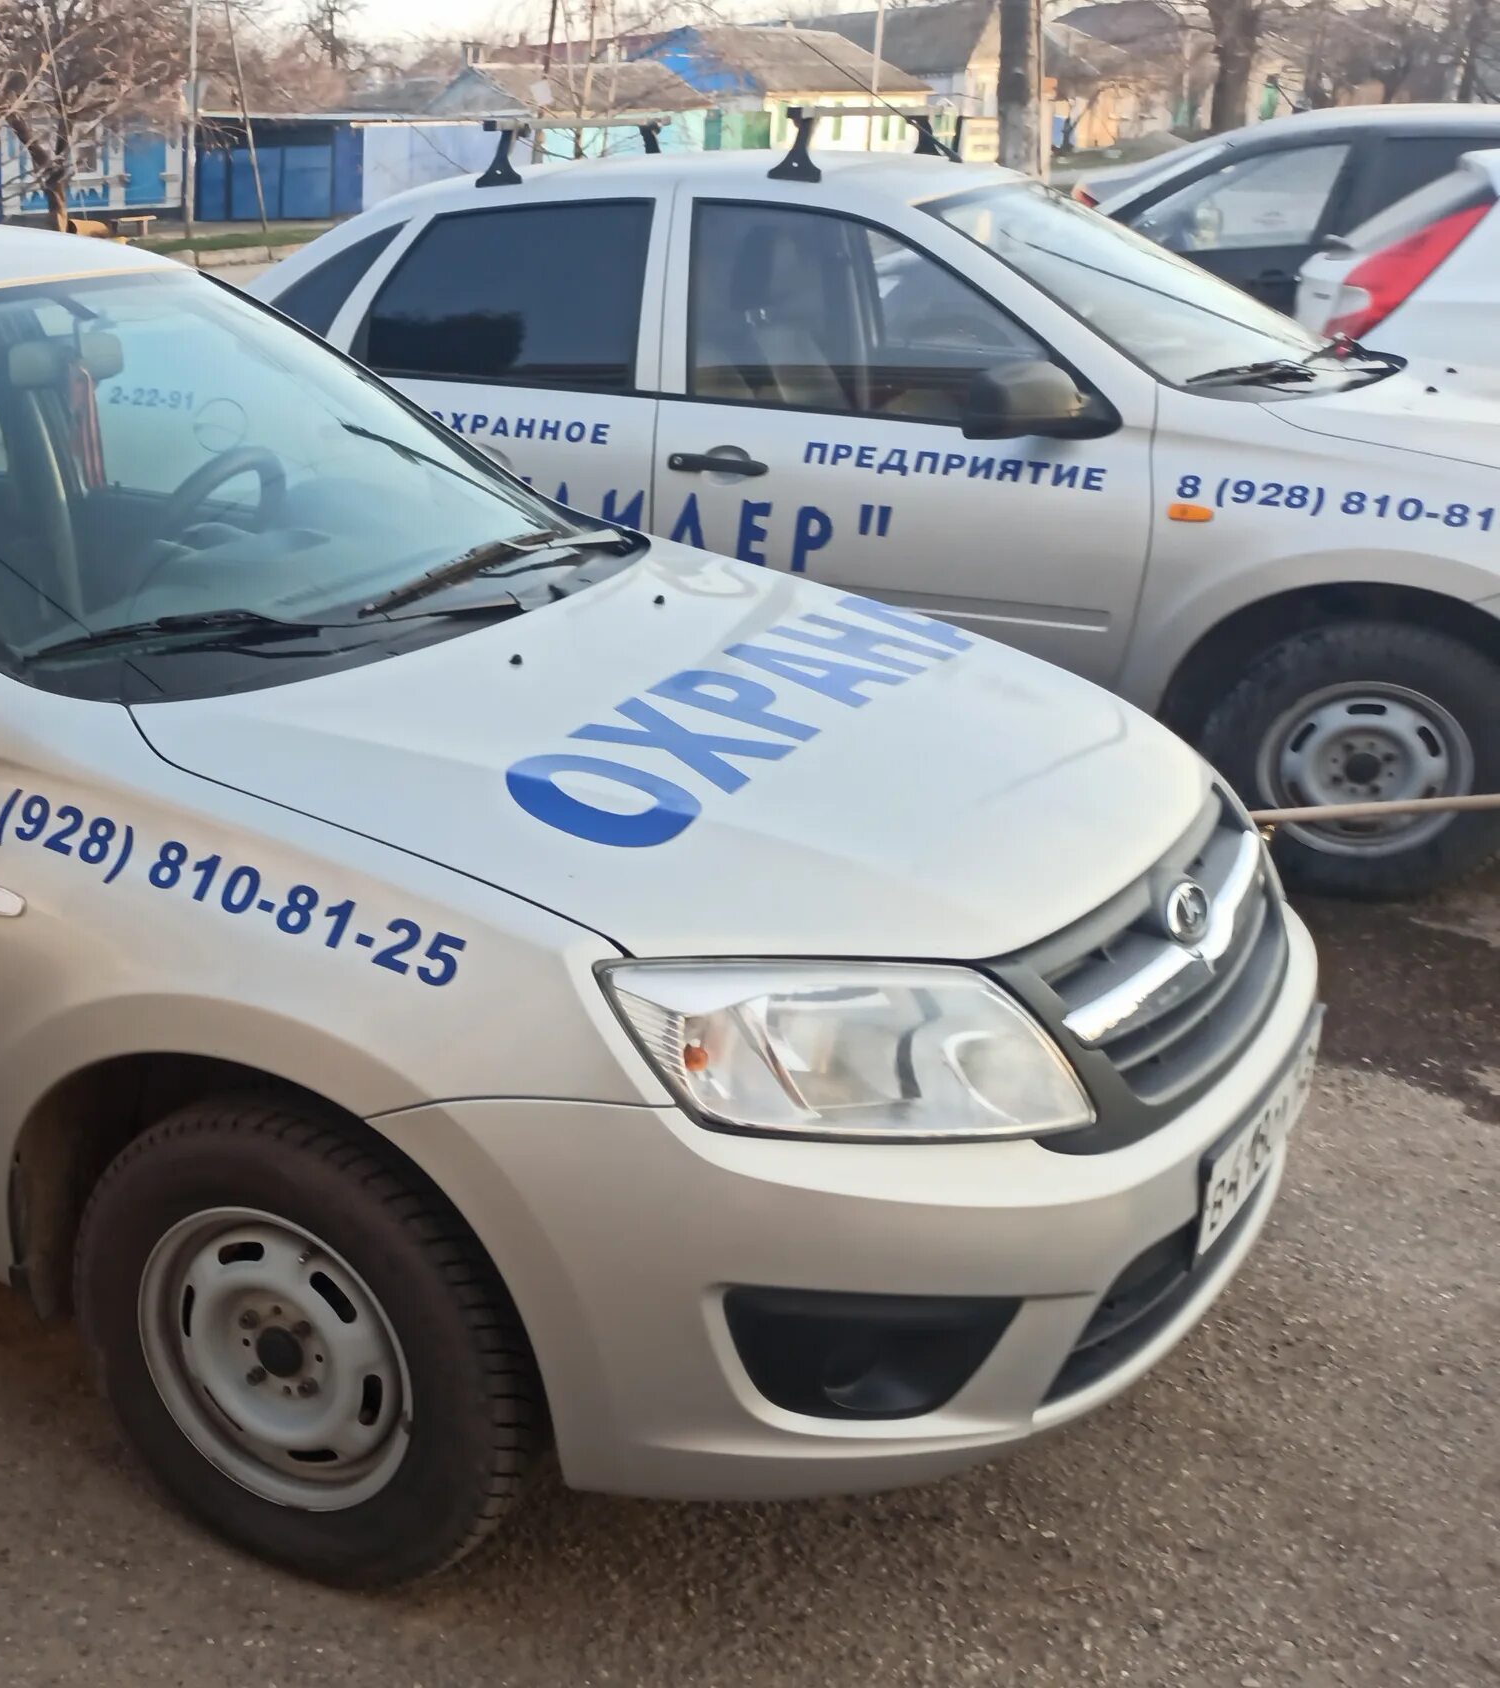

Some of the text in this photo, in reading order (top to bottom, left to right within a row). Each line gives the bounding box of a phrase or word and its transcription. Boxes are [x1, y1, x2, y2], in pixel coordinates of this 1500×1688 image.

[109, 385, 194, 411] 2-22-91
[803, 440, 1108, 492] ПРЕДПРИЯТИЕ
[1176, 474, 1202, 499] 8
[1215, 477, 1326, 517] (928)
[148, 841, 467, 987] 810-81-25
